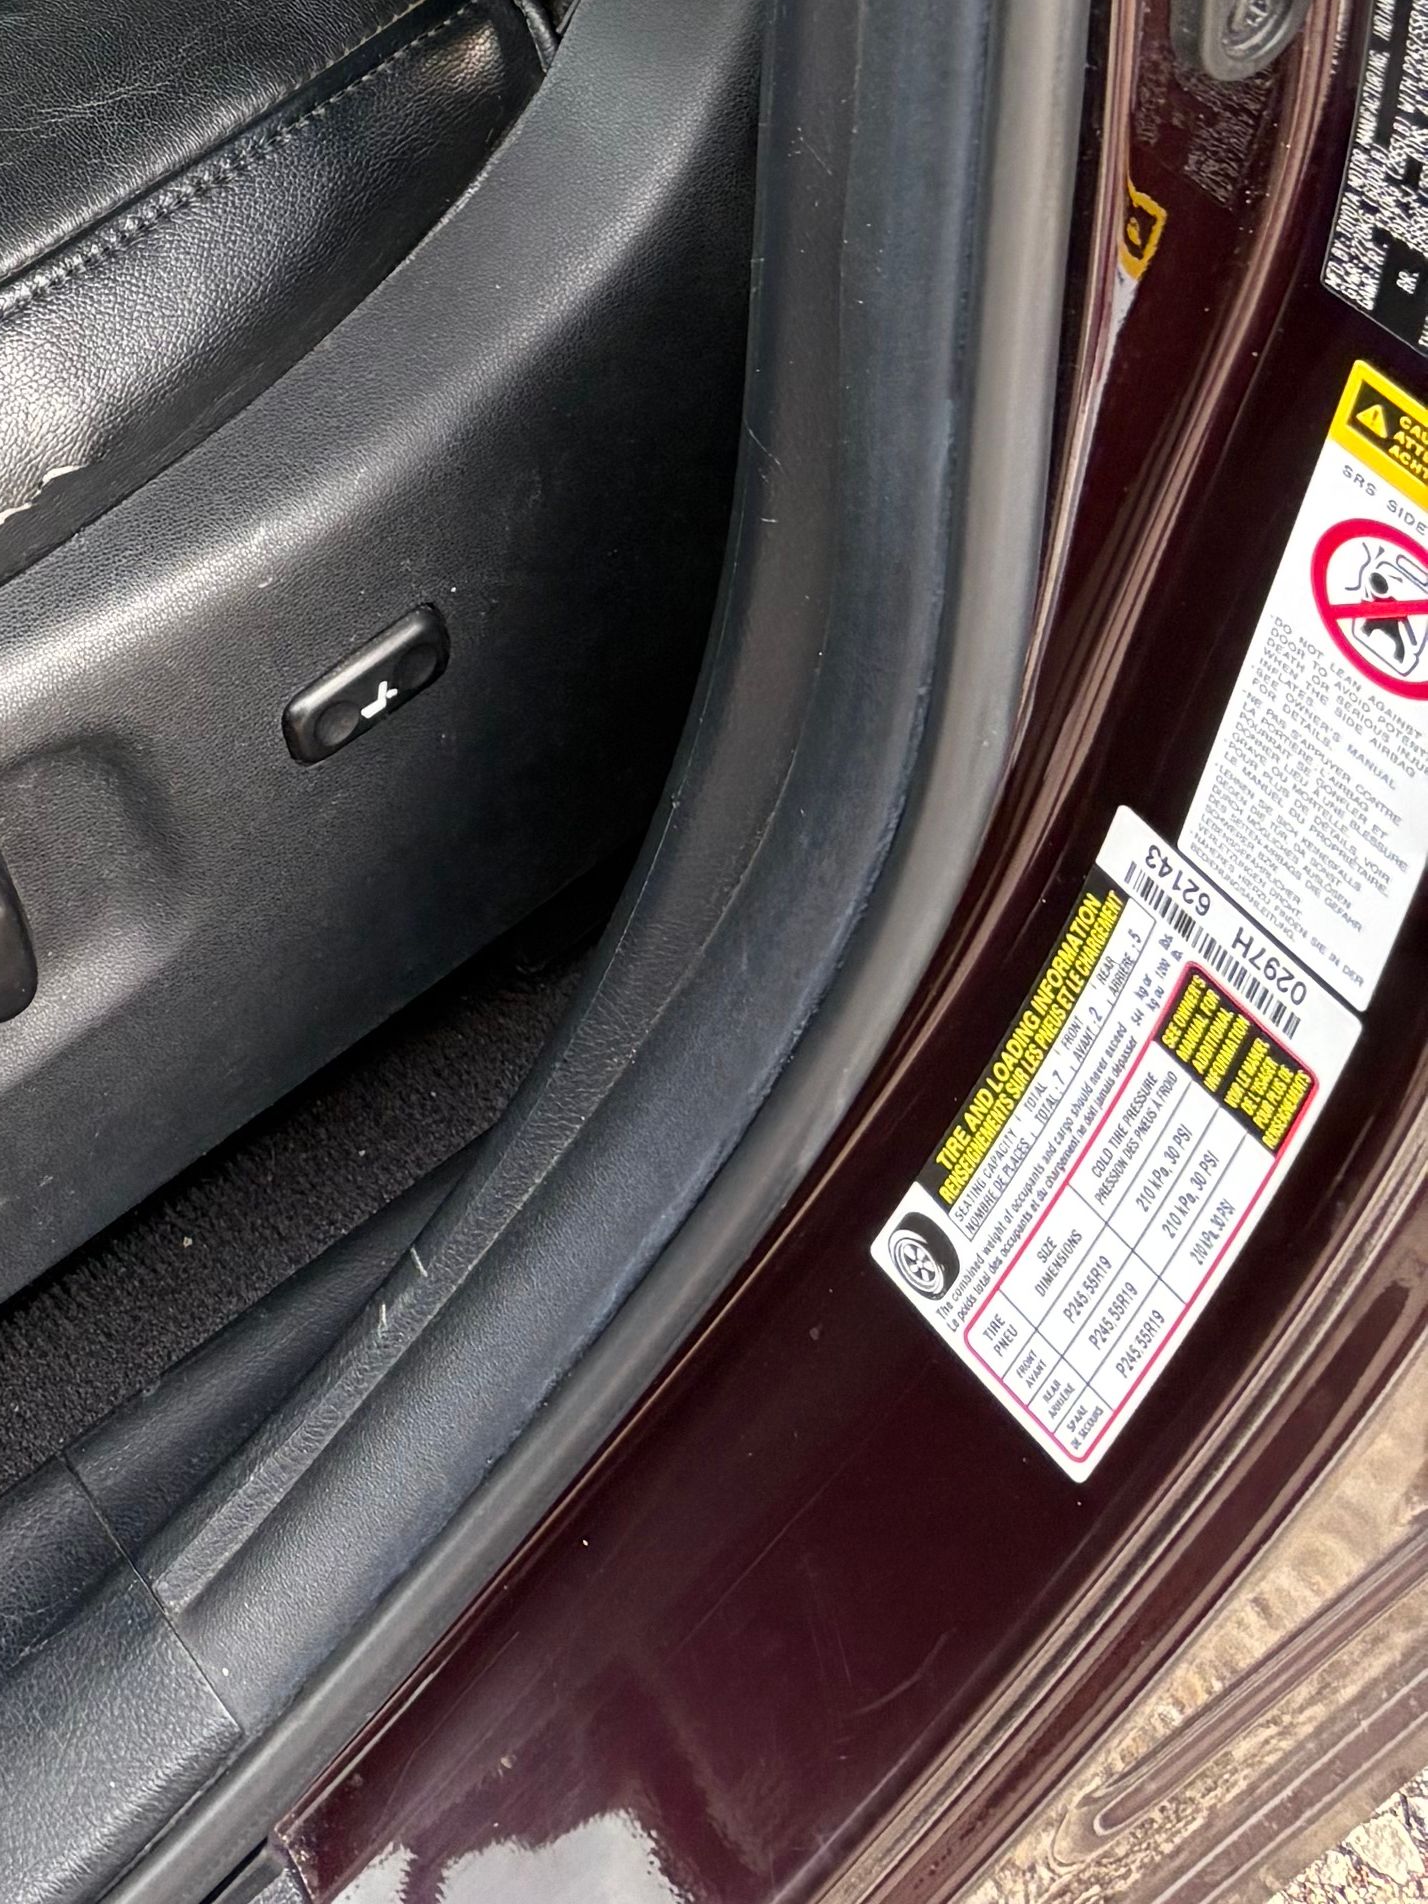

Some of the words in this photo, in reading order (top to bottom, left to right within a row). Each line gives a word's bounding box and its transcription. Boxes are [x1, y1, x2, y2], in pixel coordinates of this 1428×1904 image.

[1342, 465, 1376, 496] SRS
[1386, 499, 1428, 536] SIDE
[1266, 637, 1305, 673] DEATH
[1336, 695, 1390, 743] SERIOUS
[1270, 627, 1305, 659] DOOR
[1313, 660, 1328, 678] TO
[1334, 681, 1371, 713] AVOID
[1330, 663, 1362, 692] LEAN
[1306, 680, 1328, 706] THE
[1334, 707, 1363, 735] SIDE
[1347, 744, 1396, 790] MANUAL
[1145, 844, 1210, 916] 62143
[1070, 890, 1128, 976] CHARGEMENT
[1128, 929, 1141, 944] 5
[1065, 970, 1085, 994] LE
[1096, 956, 1116, 985] REAR
[1231, 927, 1307, 1006] 0297H
[1056, 985, 1075, 1010] ET
[1088, 1006, 1102, 1022] 2
[1162, 1022, 1182, 1049] SEE
[1173, 974, 1206, 1028] OWNER'S
[936, 1125, 971, 1170] TIRE
[964, 1088, 994, 1132] AND
[986, 1010, 1041, 1093] LOADING
[1030, 893, 1106, 1016] INFORMATION
[1034, 1004, 1066, 1050] PNEUS
[1061, 1015, 1083, 1050] FRONT
[1176, 1014, 1209, 1062] MANUAL
[1200, 989, 1220, 1016] FOR
[1192, 1007, 1234, 1074] ADDITIONAL
[1020, 1043, 1044, 1074] LES
[1052, 1070, 1064, 1085] 7
[1202, 1014, 1251, 1092] INFORMATION
[1241, 1038, 1270, 1076] MANUEL
[1005, 1067, 1030, 1099] SUR
[1024, 1082, 1047, 1112] TOTAL
[1224, 1082, 1246, 1108] VOIR
[1236, 1070, 1251, 1088] LE
[1253, 1100, 1275, 1129] POUR
[1266, 1078, 1287, 1106] PLUS
[1278, 1064, 1294, 1083] DE
[1091, 1148, 1113, 1178] COLD
[1108, 1123, 1128, 1149] TIRE
[1122, 1072, 1158, 1127] PRESSURE
[1240, 1096, 1257, 1116] DE
[939, 1085, 1014, 1209] RENSEIGNEMENTS
[1094, 1157, 1128, 1206] PRESSION
[1122, 1137, 1139, 1160] DES
[1134, 1107, 1157, 1141] PNEUS
[1156, 1071, 1178, 1102] FROID
[954, 1178, 986, 1222] SEATING
[983, 1128, 1017, 1179] CAPACITY
[965, 1189, 997, 1236] NOMBRE
[993, 1174, 1006, 1192] DE
[1002, 1137, 1030, 1179] PLACES
[1136, 1186, 1156, 1212] 210
[1164, 1146, 1180, 1165] 30
[1172, 1124, 1192, 1150] PSI
[936, 1296, 953, 1320] The
[952, 1252, 984, 1302] combined
[982, 1221, 1007, 1256] weight
[1004, 1208, 1014, 1224] of
[1011, 1164, 1045, 1213] occupants
[1042, 1141, 1057, 1164] and
[1054, 1116, 1074, 1146] cargo
[1070, 1082, 1093, 1117] should
[1162, 1212, 1182, 1239] 210
[1190, 1171, 1207, 1191] 30
[1199, 1150, 1219, 1176] PSI
[1216, 1198, 1235, 1221] PSI
[1210, 1214, 1226, 1231] 30
[946, 1318, 959, 1332] Le
[957, 1294, 977, 1322] poids
[973, 1271, 991, 1295] total
[988, 1256, 1002, 1274] des
[1000, 1211, 1033, 1258] occupants
[1030, 1199, 1040, 1212] et
[1037, 1188, 1048, 1202] du
[1034, 1229, 1082, 1297] DIMENSIONS
[1037, 1236, 1057, 1264] SIZE
[1190, 1243, 1208, 1266] 210
[982, 1313, 1005, 1341] TIRE
[993, 1324, 1018, 1357] PNEU
